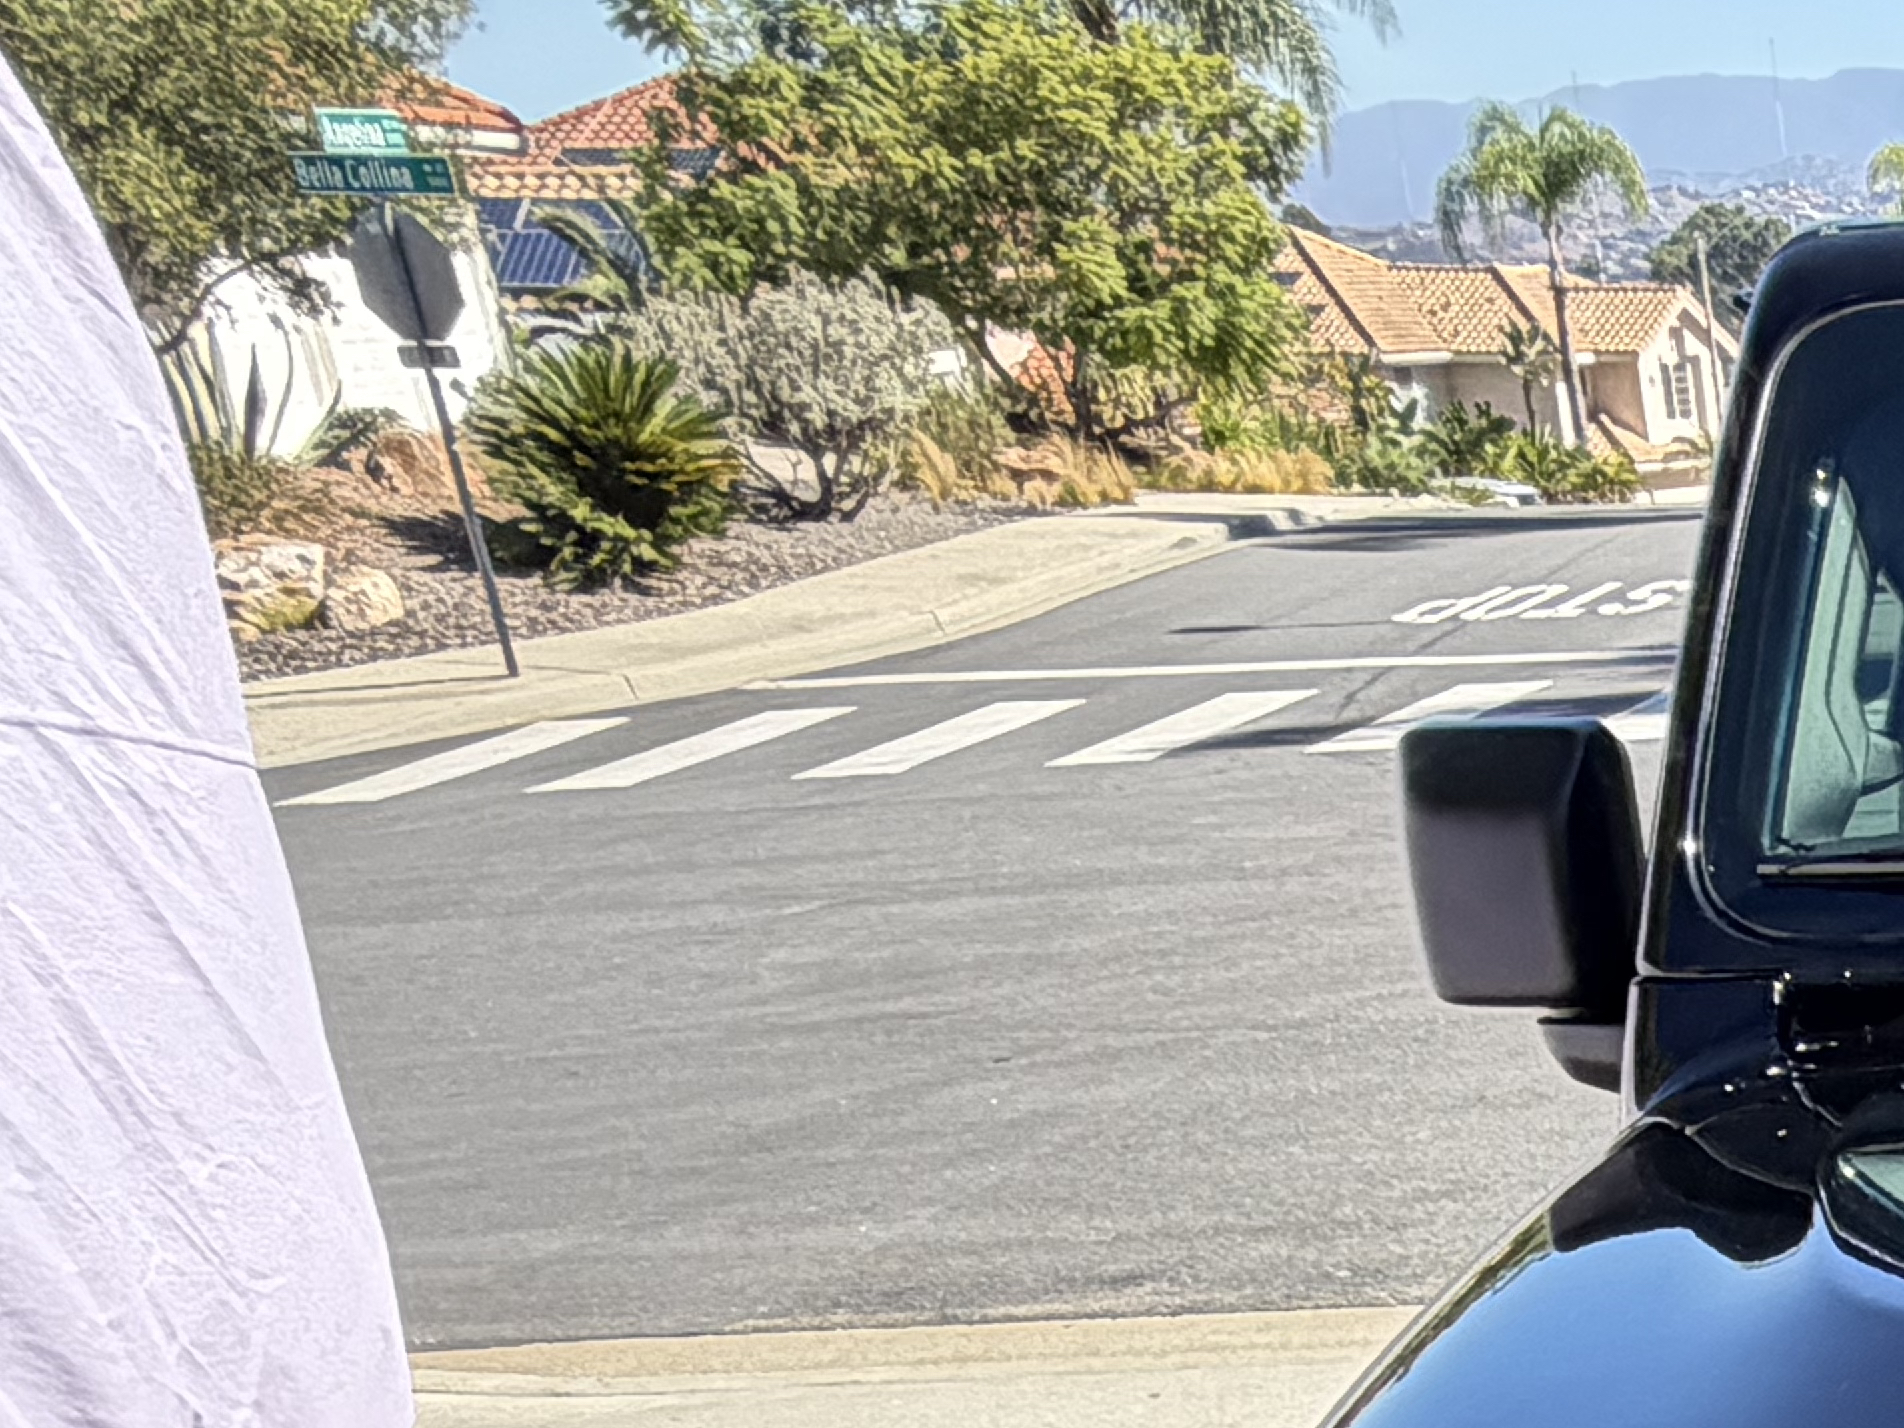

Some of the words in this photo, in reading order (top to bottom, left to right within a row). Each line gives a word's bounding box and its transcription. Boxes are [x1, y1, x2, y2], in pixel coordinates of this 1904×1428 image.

[293, 157, 344, 188] Bella
[344, 158, 415, 190] Collina
[1391, 580, 1690, 624] STOP
